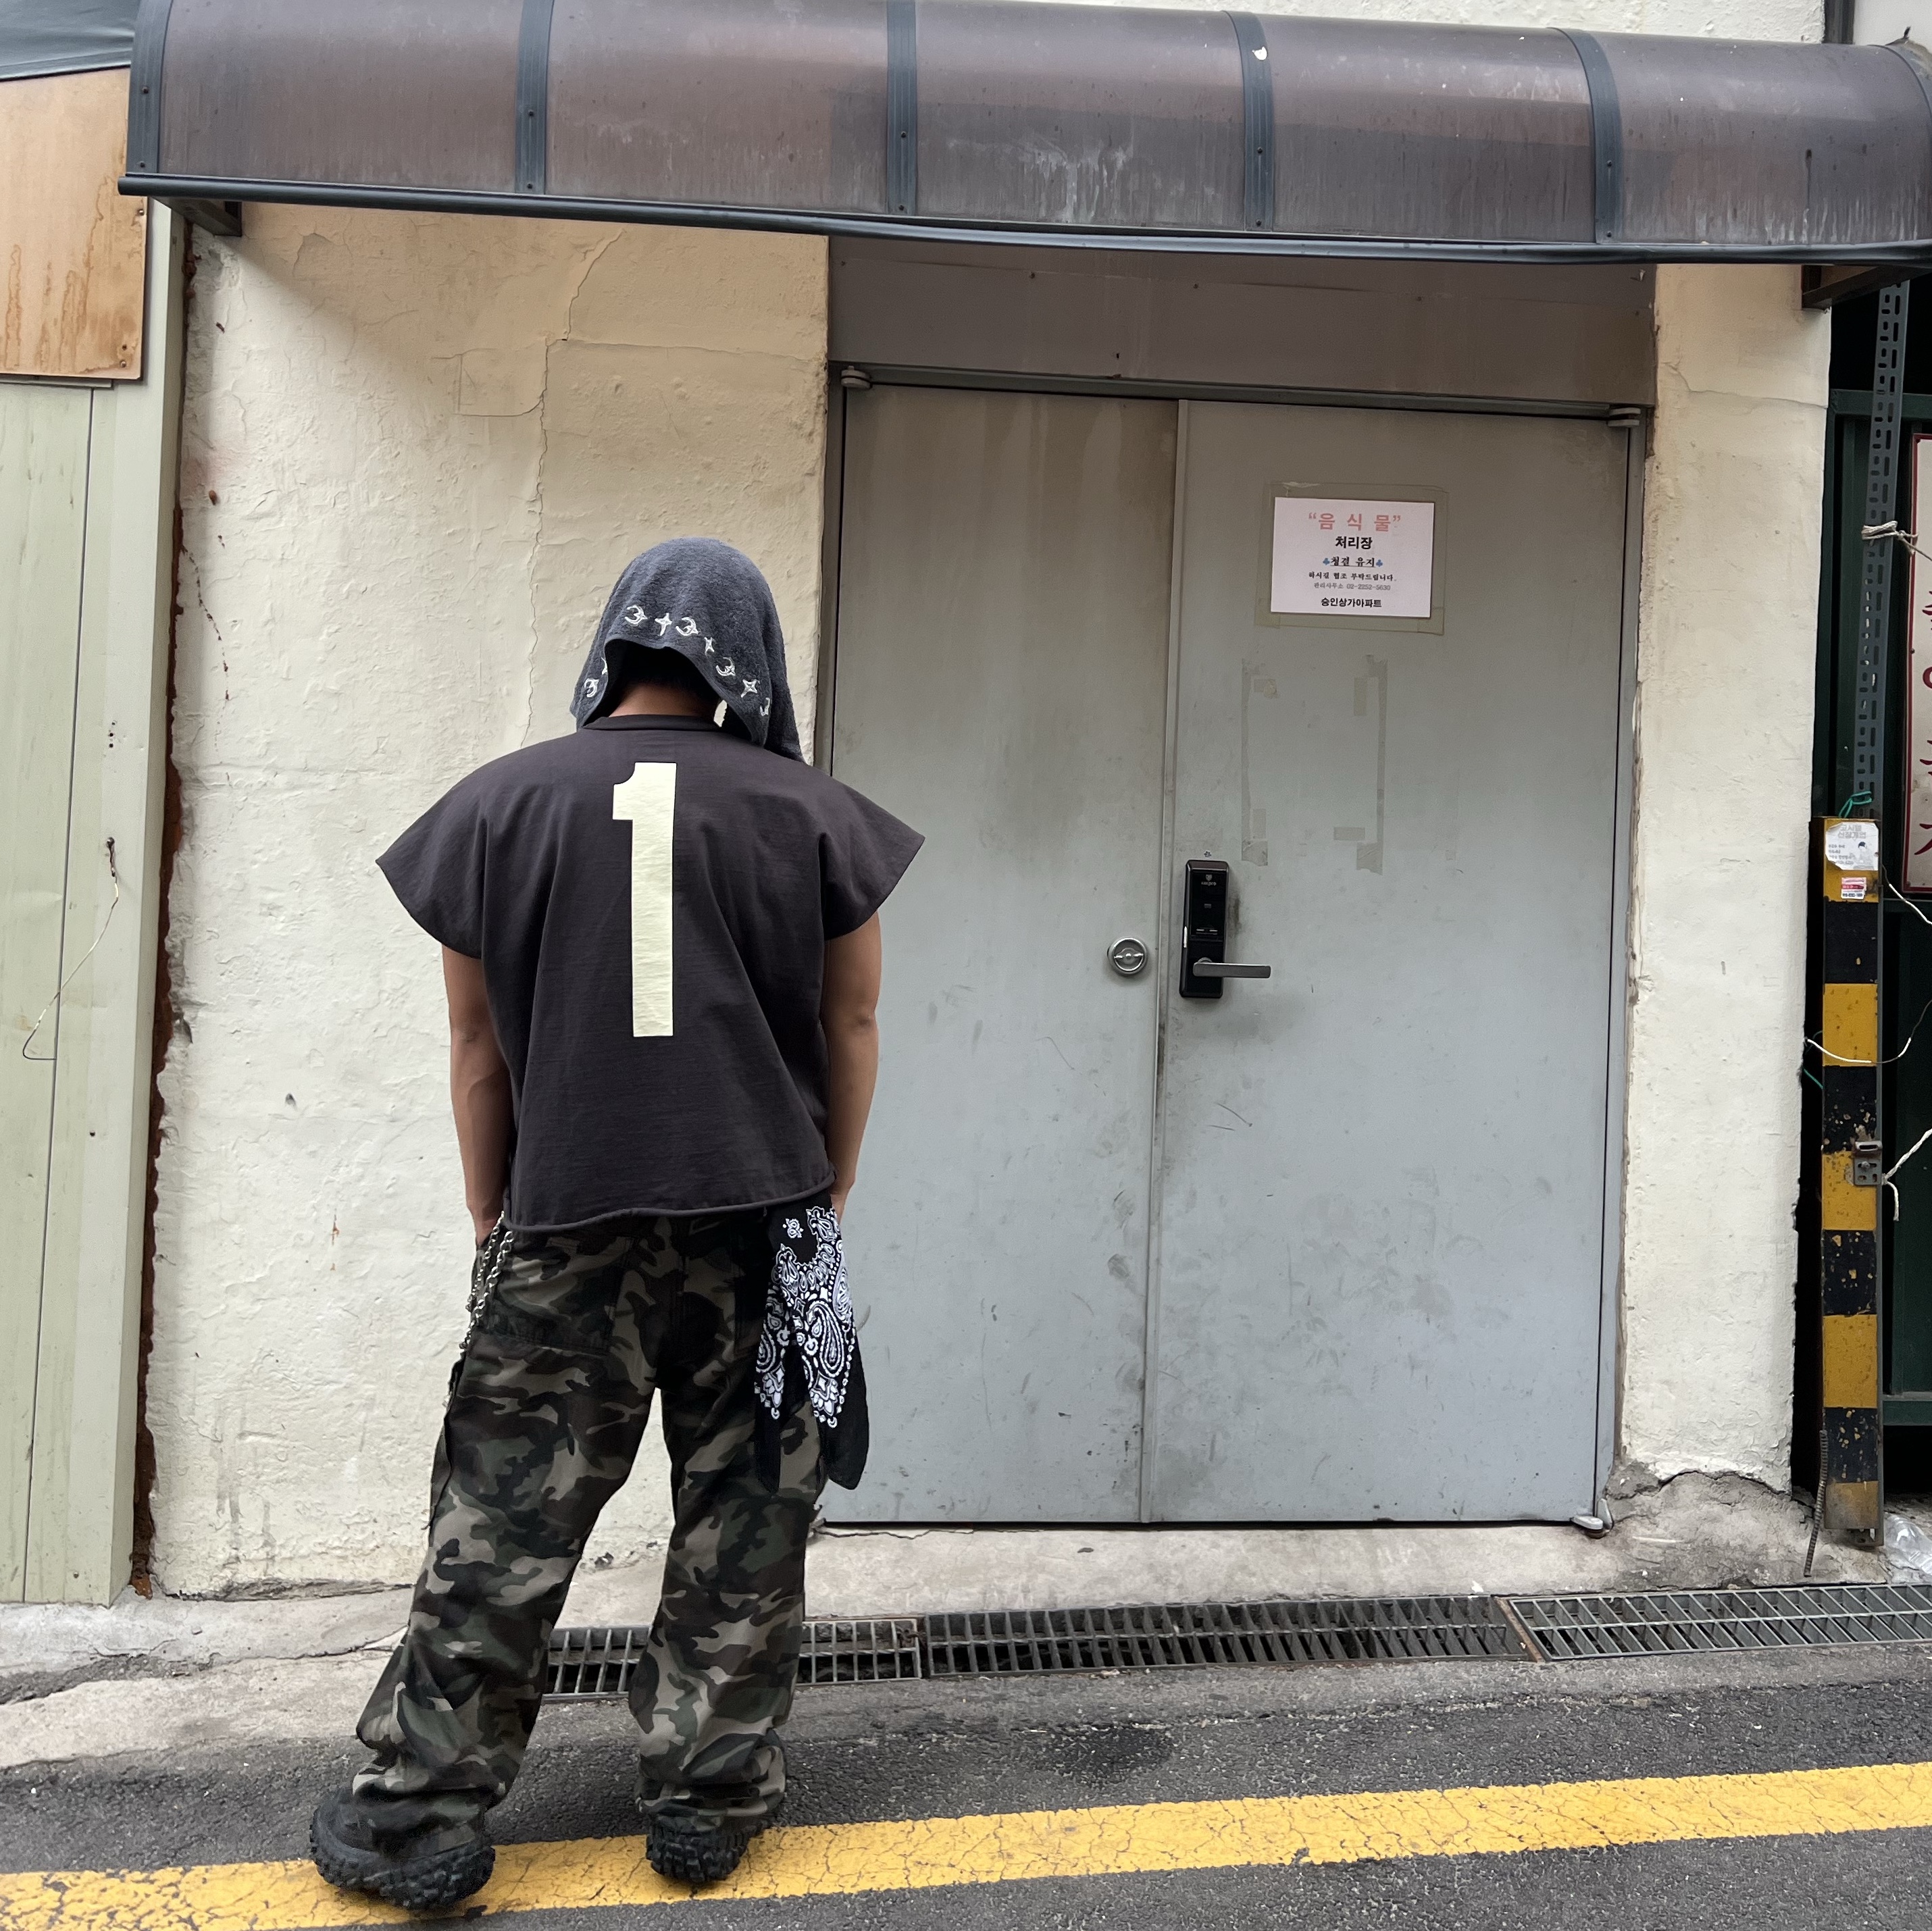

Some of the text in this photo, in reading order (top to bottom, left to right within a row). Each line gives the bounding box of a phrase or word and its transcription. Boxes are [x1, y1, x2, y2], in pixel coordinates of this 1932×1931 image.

[1335, 536, 1373, 550] 처리장
[1331, 556, 1375, 567] 청결 유지
[613, 762, 677, 1037] 1
